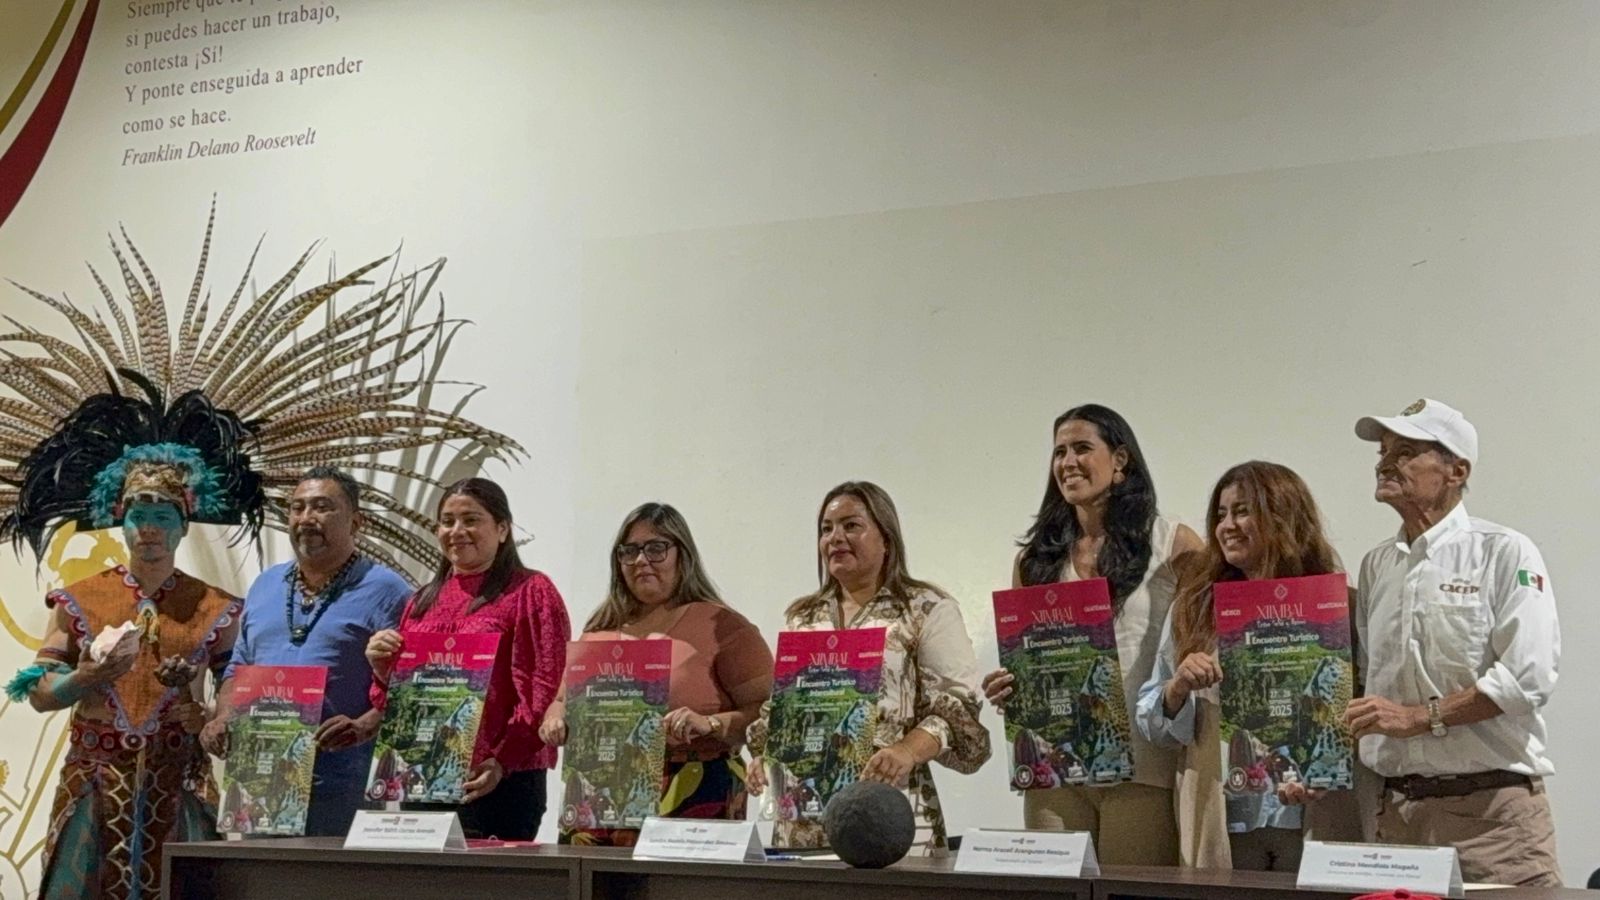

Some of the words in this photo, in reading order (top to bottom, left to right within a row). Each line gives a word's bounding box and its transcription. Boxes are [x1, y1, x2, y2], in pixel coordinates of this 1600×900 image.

[128, 0, 190, 19] Siempre
[126, 33, 139, 47] si
[144, 22, 198, 50] puedes
[203, 19, 247, 37] hacer
[252, 17, 271, 30] un
[278, 6, 340, 26] trabajo,
[125, 53, 188, 75] contesta
[125, 85, 137, 102] Y
[142, 81, 185, 105] ponte
[190, 69, 269, 94] enseguida
[276, 71, 284, 84] a
[290, 57, 363, 85] aprender
[122, 115, 164, 135] como
[170, 113, 185, 129] se
[191, 108, 231, 127] hace.
[121, 143, 183, 166] Franklin
[187, 139, 240, 160] Delano
[243, 127, 316, 153] Roosevelt
[1252, 635, 1288, 645] Encuentro
[1289, 632, 1319, 642] Turístico
[1264, 645, 1308, 654] Intercultural
[1050, 703, 1072, 716] 2025
[1270, 704, 1292, 717] 2025
[804, 741, 823, 752] 2025
[597, 751, 616, 761] 2025
